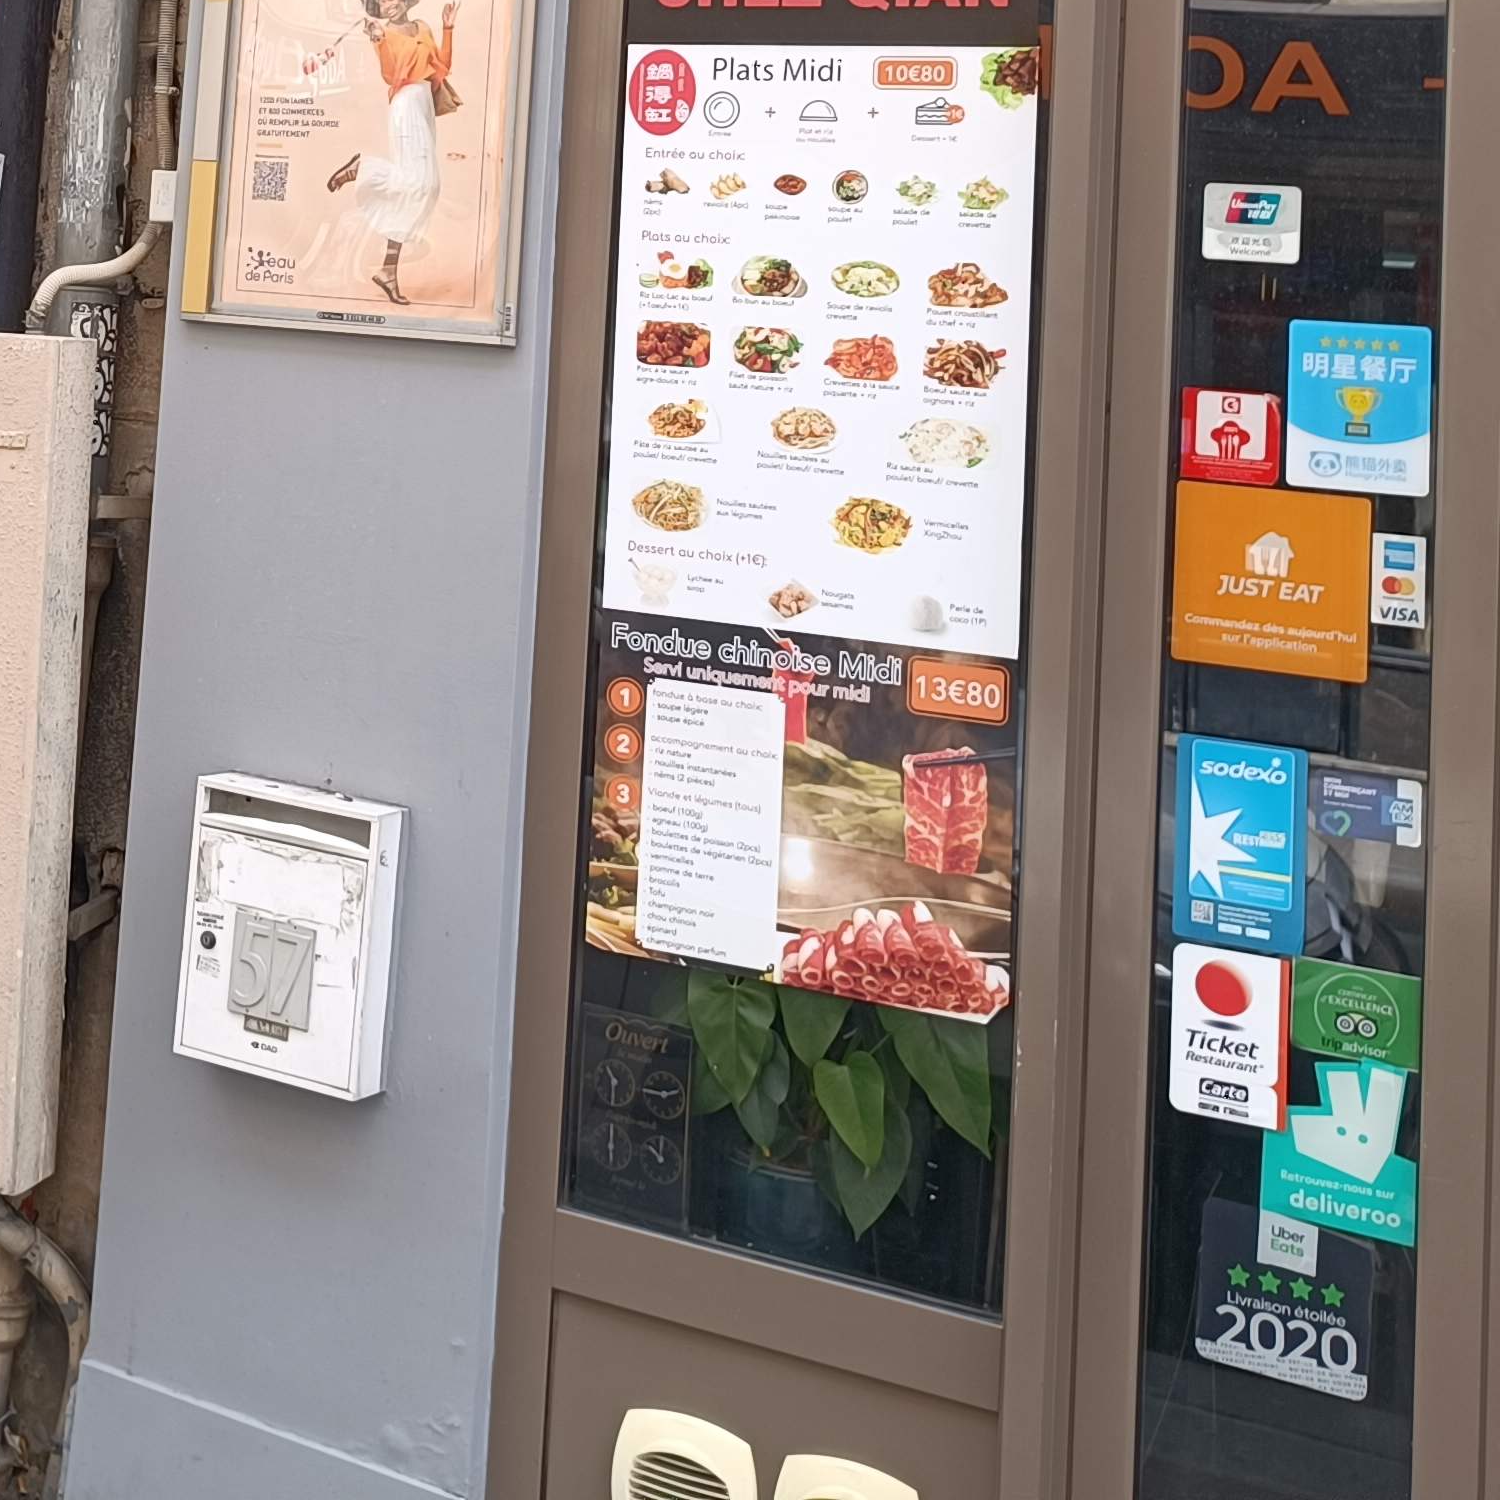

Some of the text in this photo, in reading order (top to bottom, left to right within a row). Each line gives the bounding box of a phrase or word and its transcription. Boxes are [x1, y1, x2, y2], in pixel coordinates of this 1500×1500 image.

[712, 57, 946, 83] Plats Midi 10€80
[645, 147, 746, 161] Entrée au choix
[641, 230, 731, 245] Plats au choix
[1229, 245, 1271, 257] Welcome
[244, 268, 295, 285] de Paris
[1302, 351, 1418, 384] 明星餐厅
[627, 540, 733, 563] Dessert au choix
[1217, 574, 1325, 604] JUST EAT
[1184, 612, 1262, 632] Commandez
[1286, 623, 1357, 644] aujourd'hui
[1379, 605, 1420, 624] VISA
[611, 621, 903, 687] Fondue chinoise Midi
[1221, 632, 1318, 654] sur l'application
[643, 656, 871, 704] Servi uniquement pour midi
[915, 674, 1001, 710] 13€80
[720, 699, 733, 708] au
[735, 699, 764, 712] choix
[650, 734, 735, 754] accompagnement
[736, 746, 750, 756] au
[750, 747, 780, 761] choix
[1199, 758, 1288, 785] sodexo
[230, 919, 313, 1017] 57
[605, 1021, 669, 1054] Ouvert
[1186, 1028, 1260, 1060] Ticket
[1321, 1036, 1388, 1059] tripadvisor
[1185, 1050, 1260, 1074] Restaurant
[1201, 1079, 1247, 1101] Carte
[1280, 1168, 1396, 1200] Retrouvez-nous sur
[1289, 1189, 1402, 1229] deliveroo
[1270, 1224, 1306, 1244] Uber
[1269, 1238, 1305, 1258] Eats
[1226, 1290, 1347, 1328] Livraison étoilée
[1215, 1303, 1358, 1374] 2020
